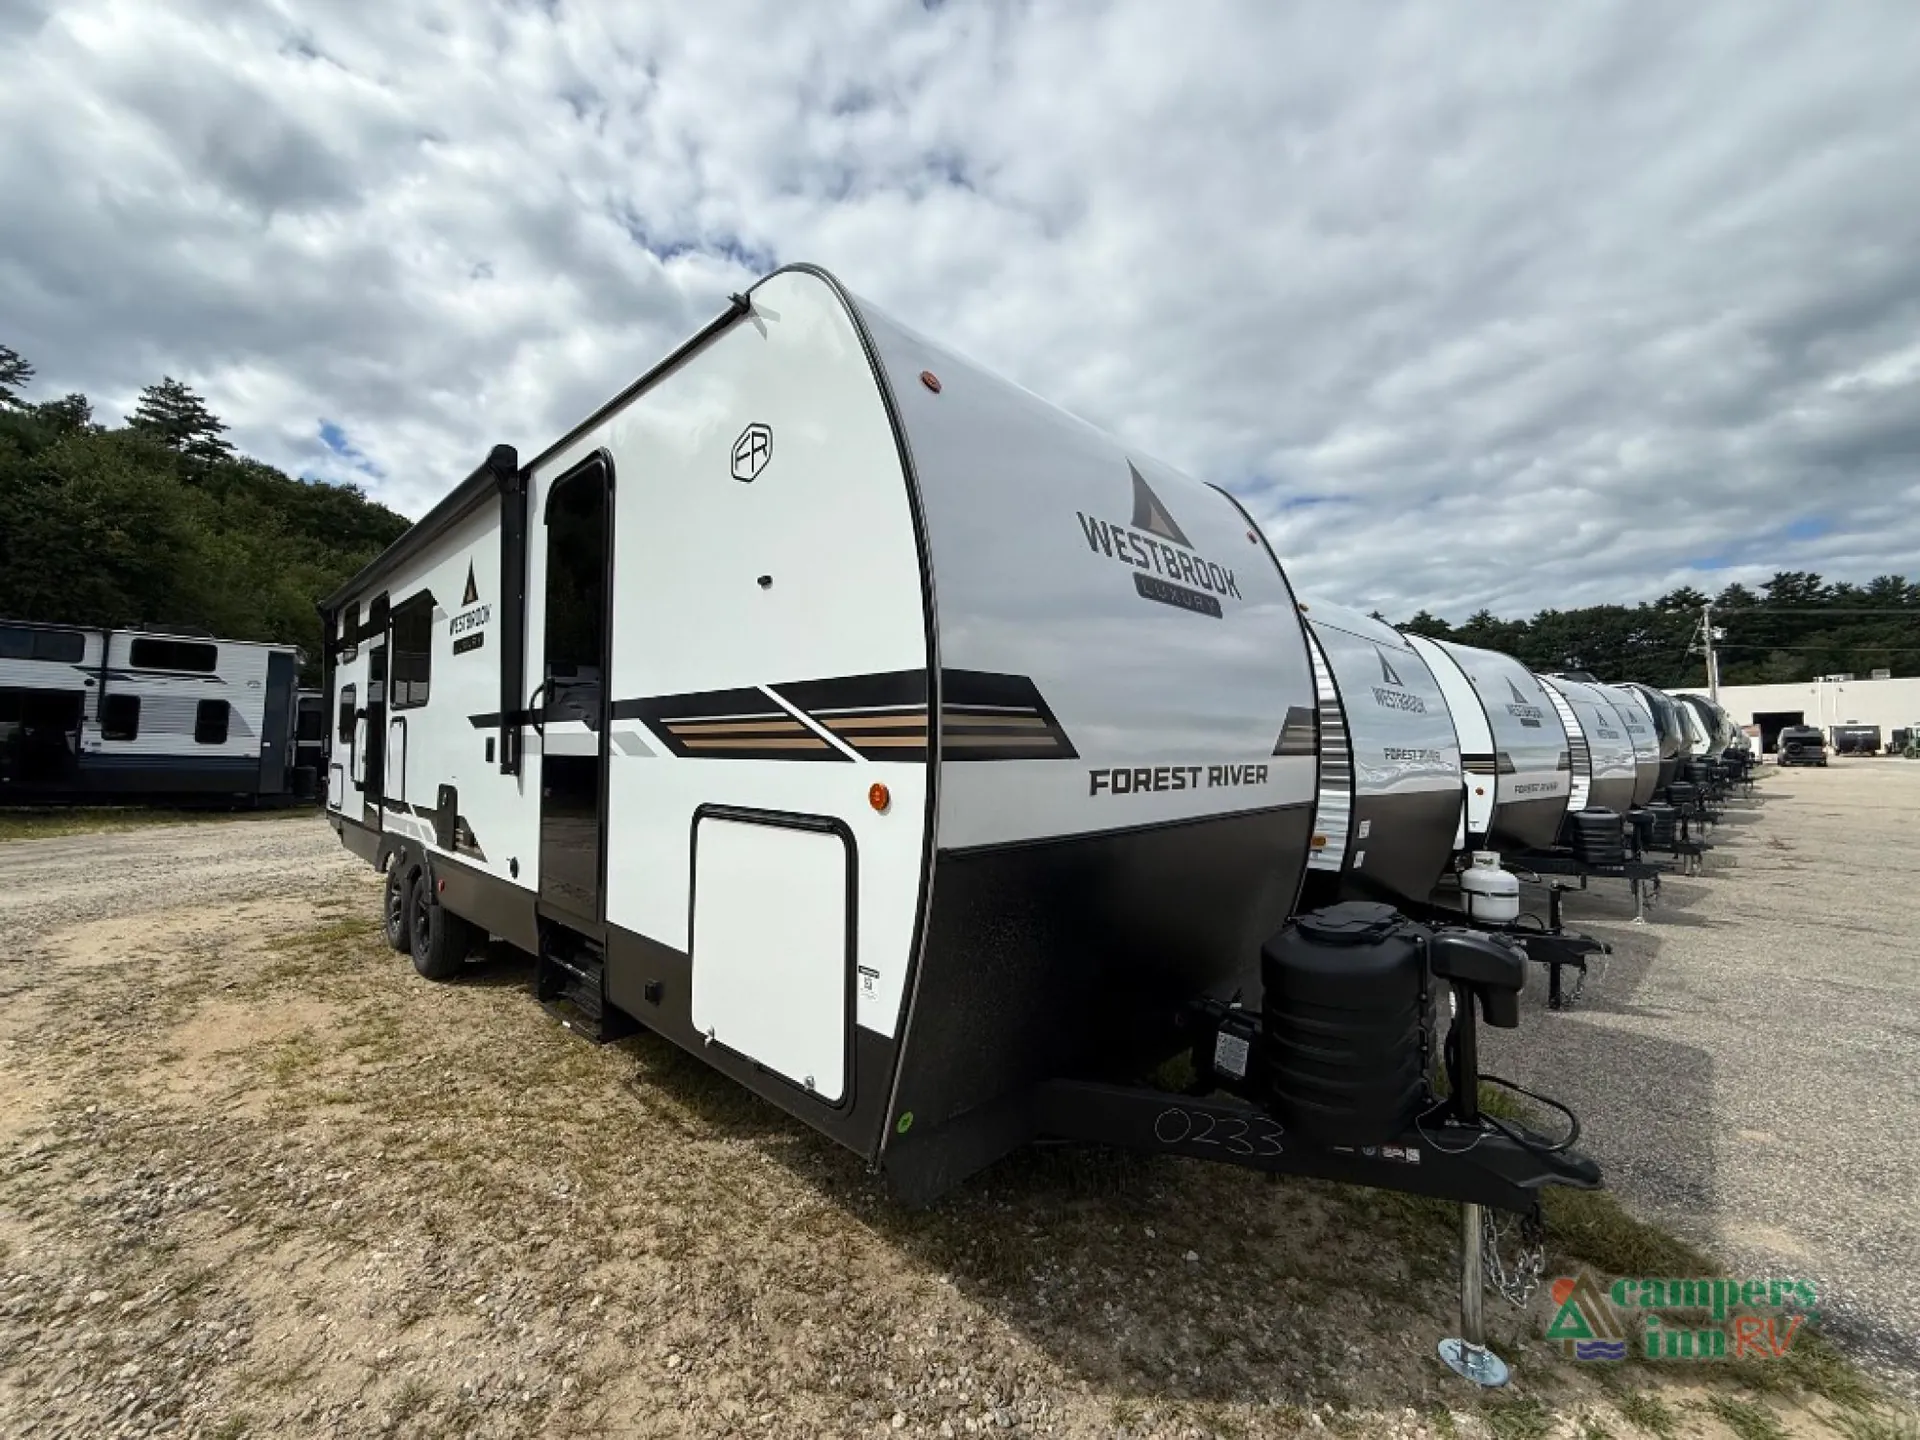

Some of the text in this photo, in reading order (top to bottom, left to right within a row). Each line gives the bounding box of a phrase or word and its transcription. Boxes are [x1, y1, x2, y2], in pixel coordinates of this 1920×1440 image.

[1075, 510, 1243, 601] WESTBROOK
[1089, 764, 1268, 796] FOREST RIVER
[1154, 1107, 1286, 1156] 0233
